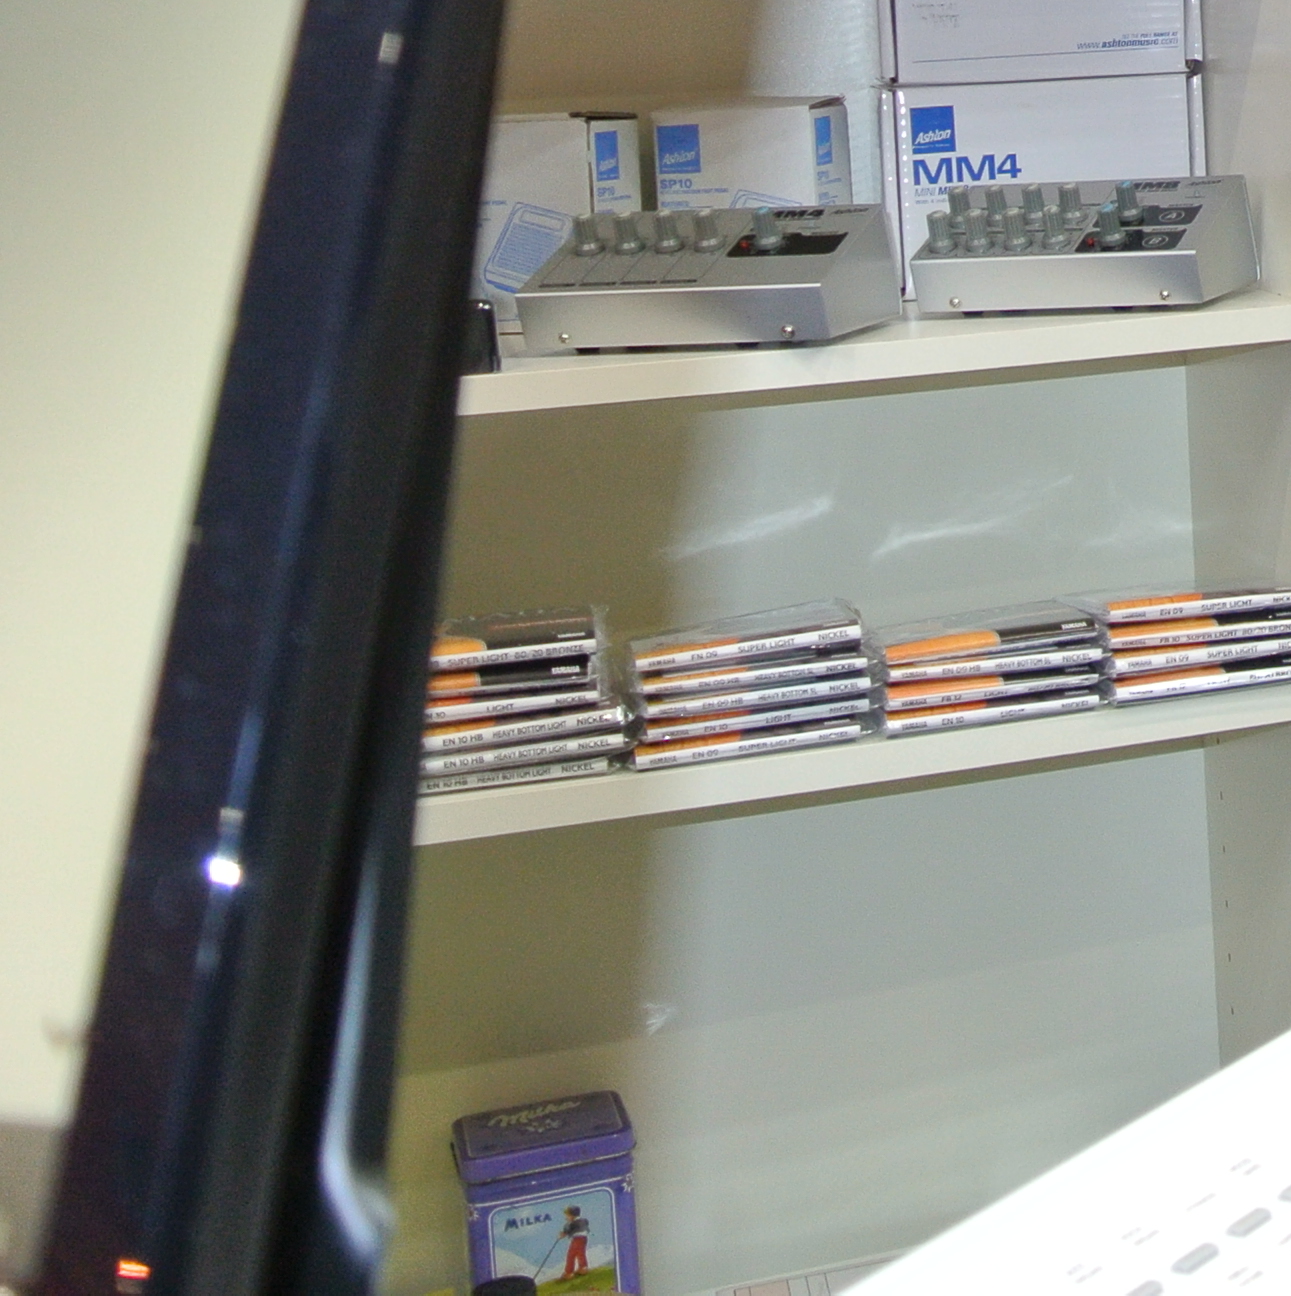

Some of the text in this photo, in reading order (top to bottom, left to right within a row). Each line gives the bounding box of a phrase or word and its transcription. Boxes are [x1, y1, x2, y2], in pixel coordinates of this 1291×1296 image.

[914, 128, 952, 145] Ashton
[662, 151, 697, 166] Ashton
[911, 152, 1023, 186] MM4
[659, 178, 693, 190] SP10
[737, 629, 850, 654] SUPER LIGHT NICKEL
[1061, 653, 1093, 664] NICKEL
[1206, 648, 1234, 660] SUPER
[1234, 644, 1260, 656] LIGHT
[828, 681, 862, 694] NICKEL
[442, 736, 456, 747] EN
[457, 735, 468, 746] 10
[469, 733, 484, 743] HB
[517, 723, 547, 735] BOTTOM
[576, 714, 611, 727] NICKEL
[443, 759, 457, 770] EN
[458, 757, 469, 768] 10
[470, 755, 485, 766] HB
[517, 746, 548, 758] BOTTOM
[577, 738, 611, 751] NICKEL
[560, 761, 595, 774] NICKEL
[504, 1212, 553, 1232] MILKA
